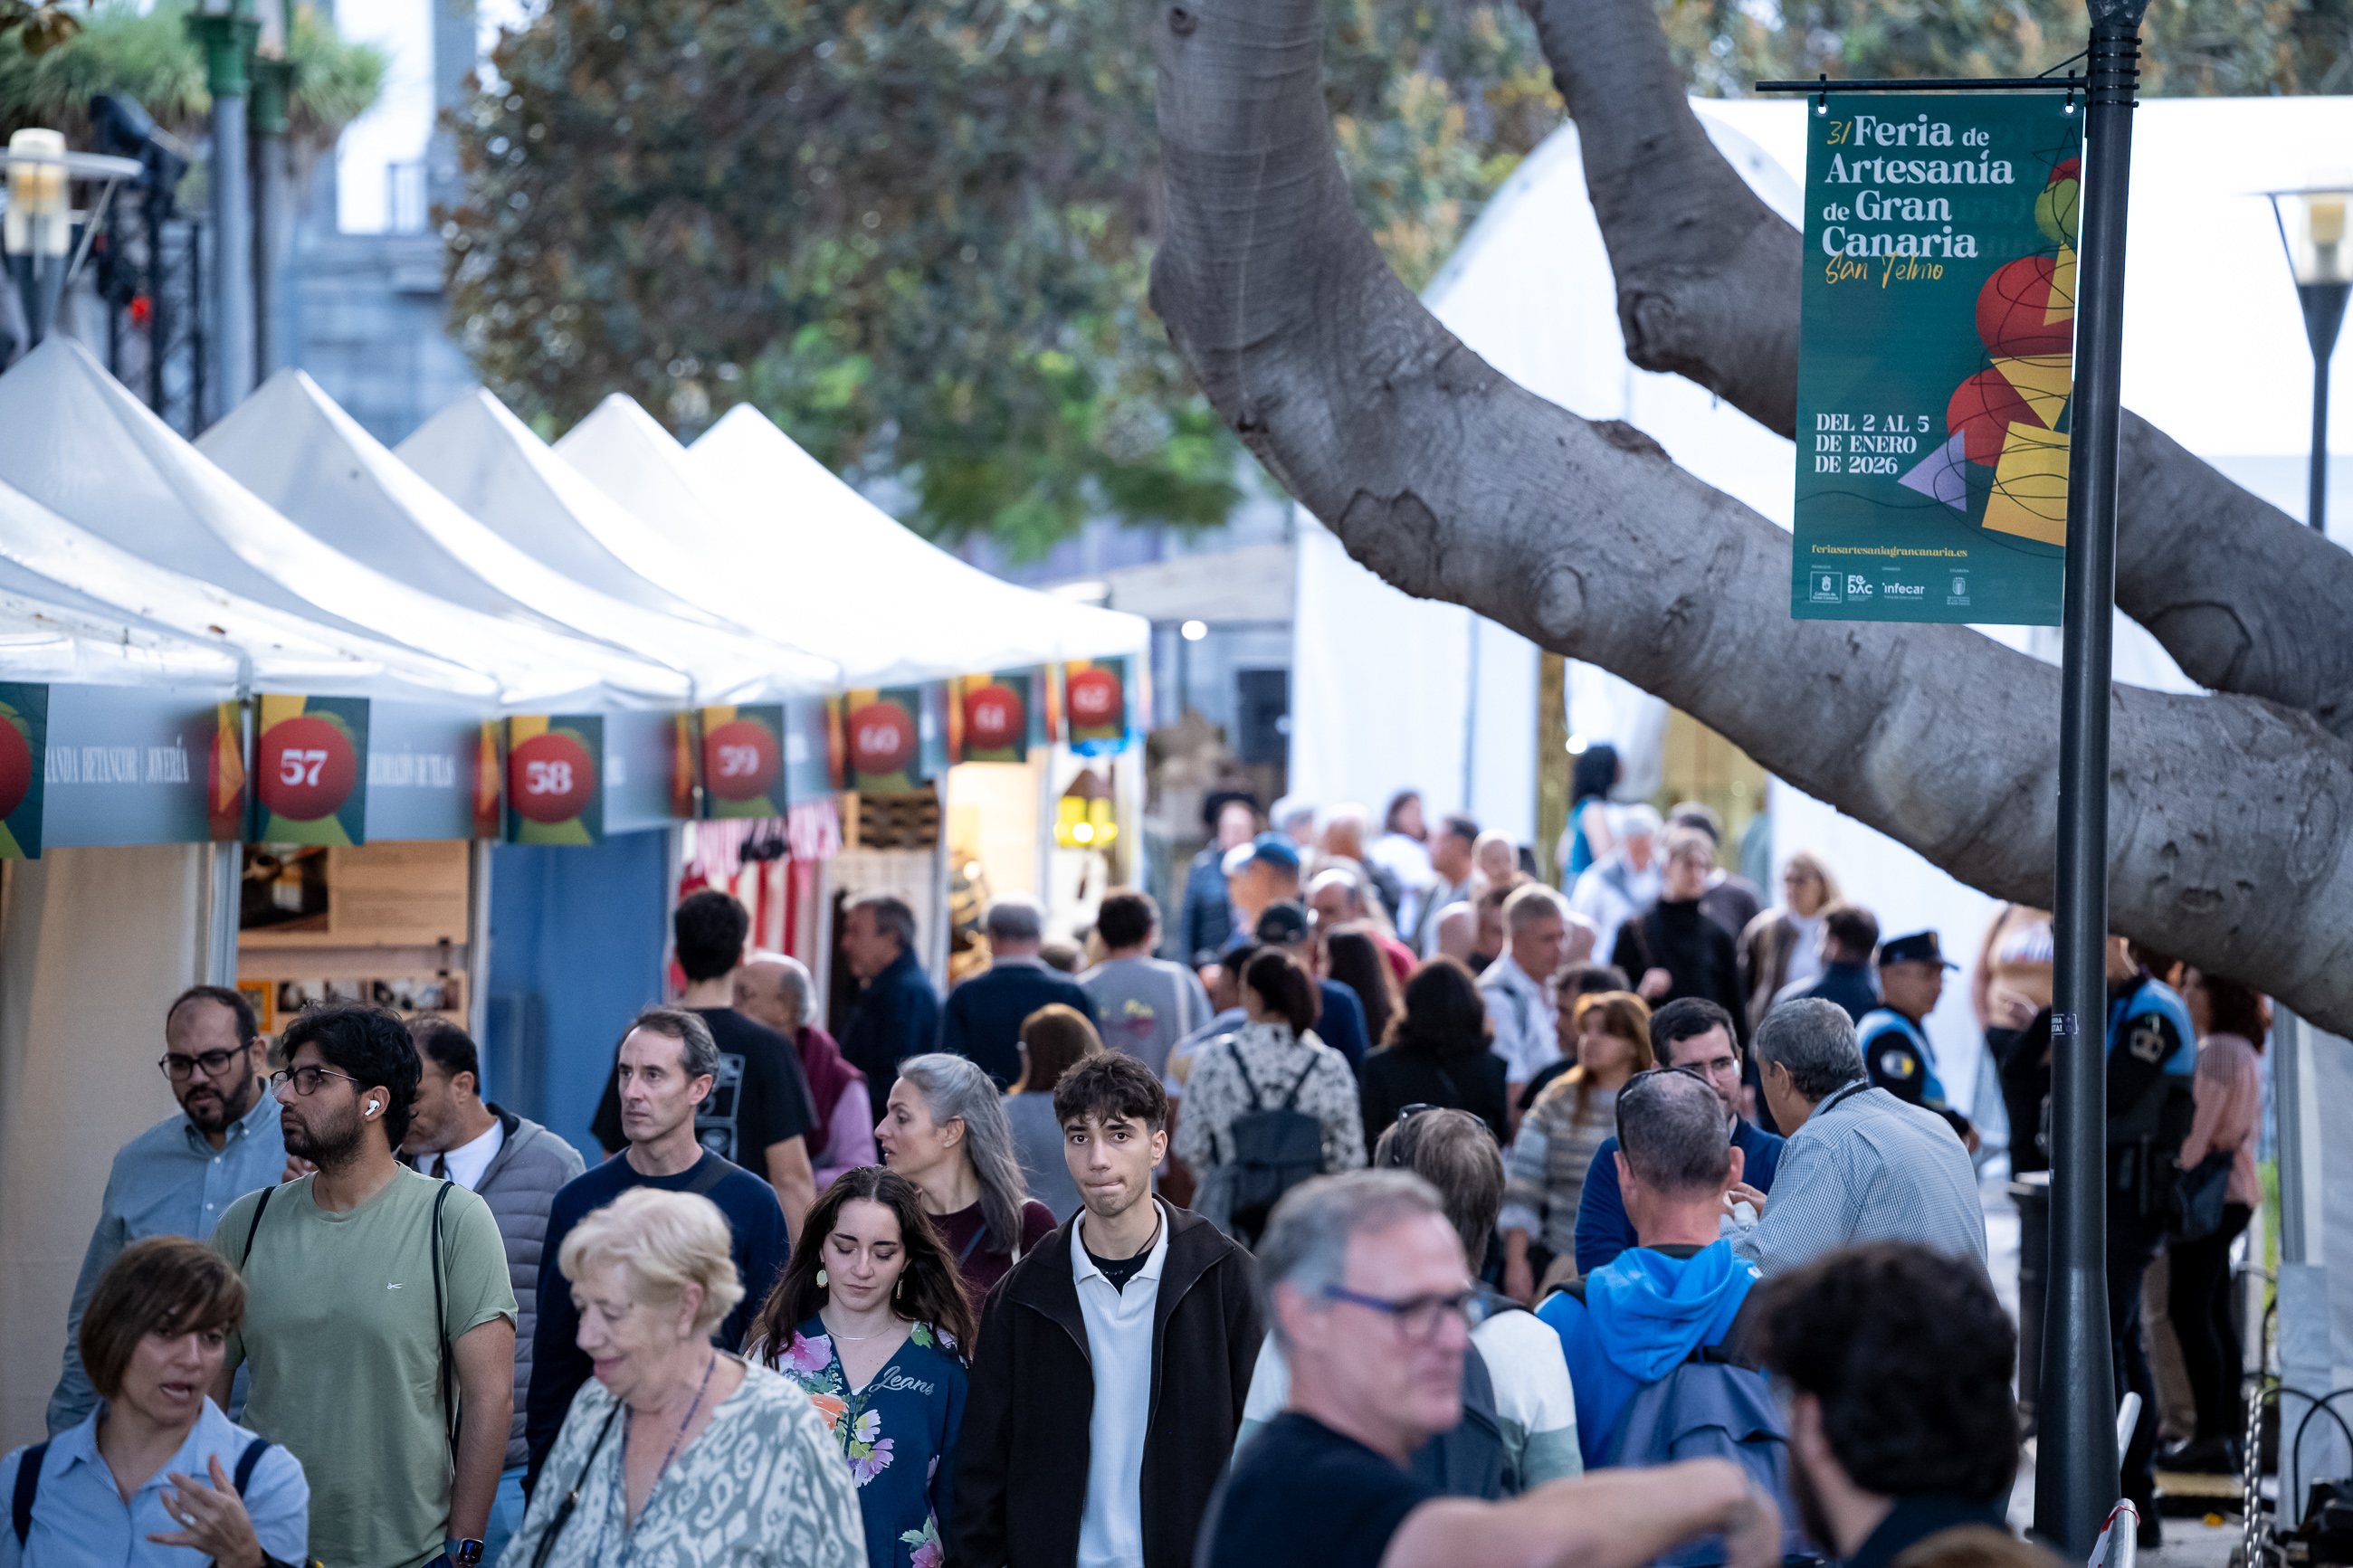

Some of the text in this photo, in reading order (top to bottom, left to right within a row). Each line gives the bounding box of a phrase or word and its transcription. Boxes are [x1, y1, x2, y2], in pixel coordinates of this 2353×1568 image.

[1826, 114, 1990, 147] 31 Feria de
[1824, 149, 2015, 185] Artesanía
[1823, 190, 1953, 222] de Gran
[1822, 225, 1978, 259] Canaria
[1824, 251, 1944, 289] San Telmo
[1815, 413, 1930, 432] DEL 2 AL 5
[1815, 434, 1917, 454] DE ENERO
[1815, 455, 1899, 475] DE 2026
[1812, 544, 1968, 558] feriasartesaniagrancanaria.es
[1882, 582, 1925, 594] infecar
[280, 749, 329, 785] 57
[718, 744, 760, 776] 59
[524, 760, 573, 795] 58
[868, 1364, 935, 1396] Jeans
